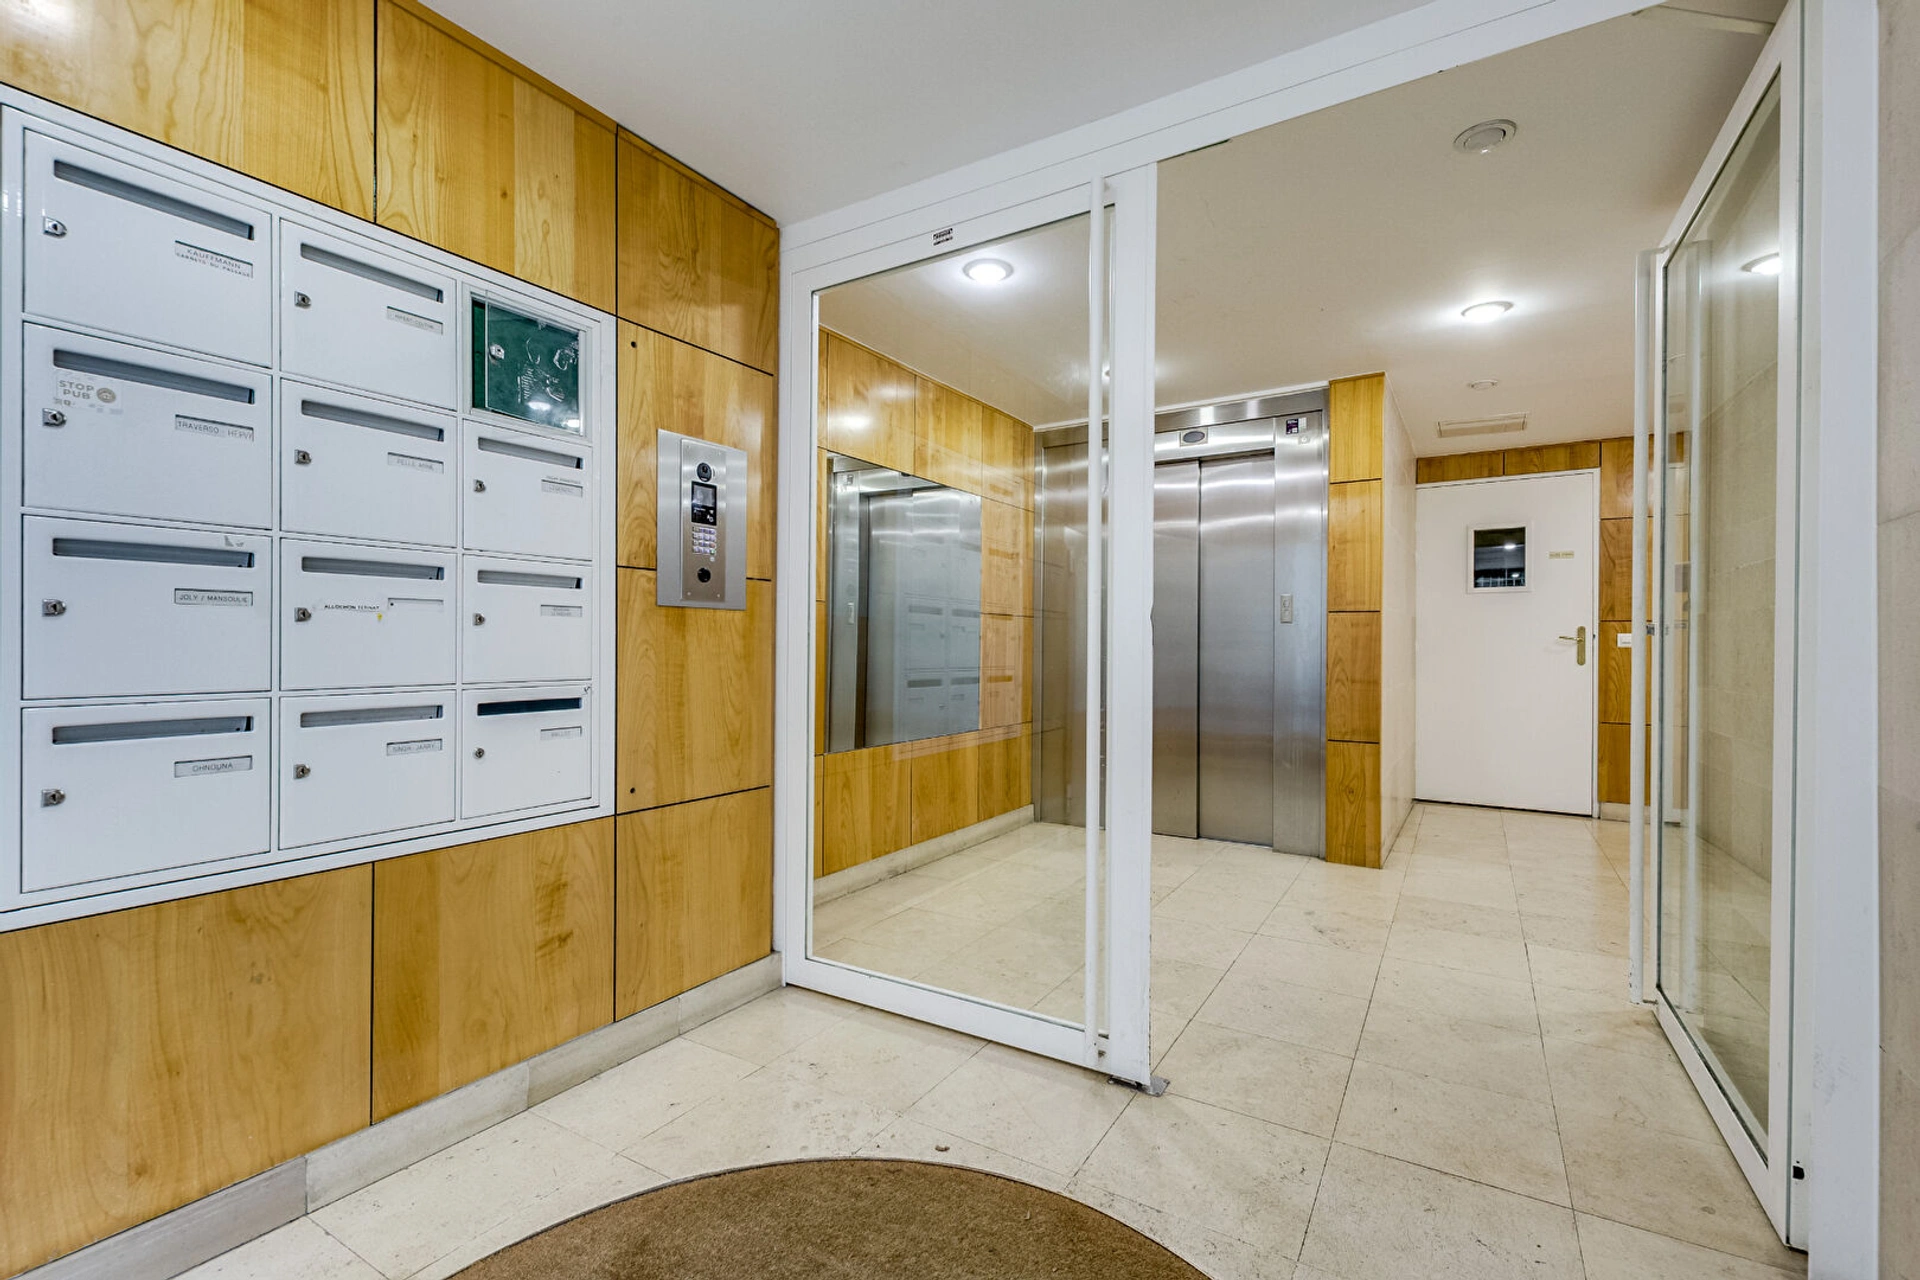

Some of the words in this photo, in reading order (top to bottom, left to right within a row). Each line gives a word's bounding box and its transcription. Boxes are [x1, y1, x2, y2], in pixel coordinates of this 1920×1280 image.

[59, 379, 94, 391] STOP
[63, 388, 90, 399] PUB
[178, 420, 219, 434] TRAVERSO
